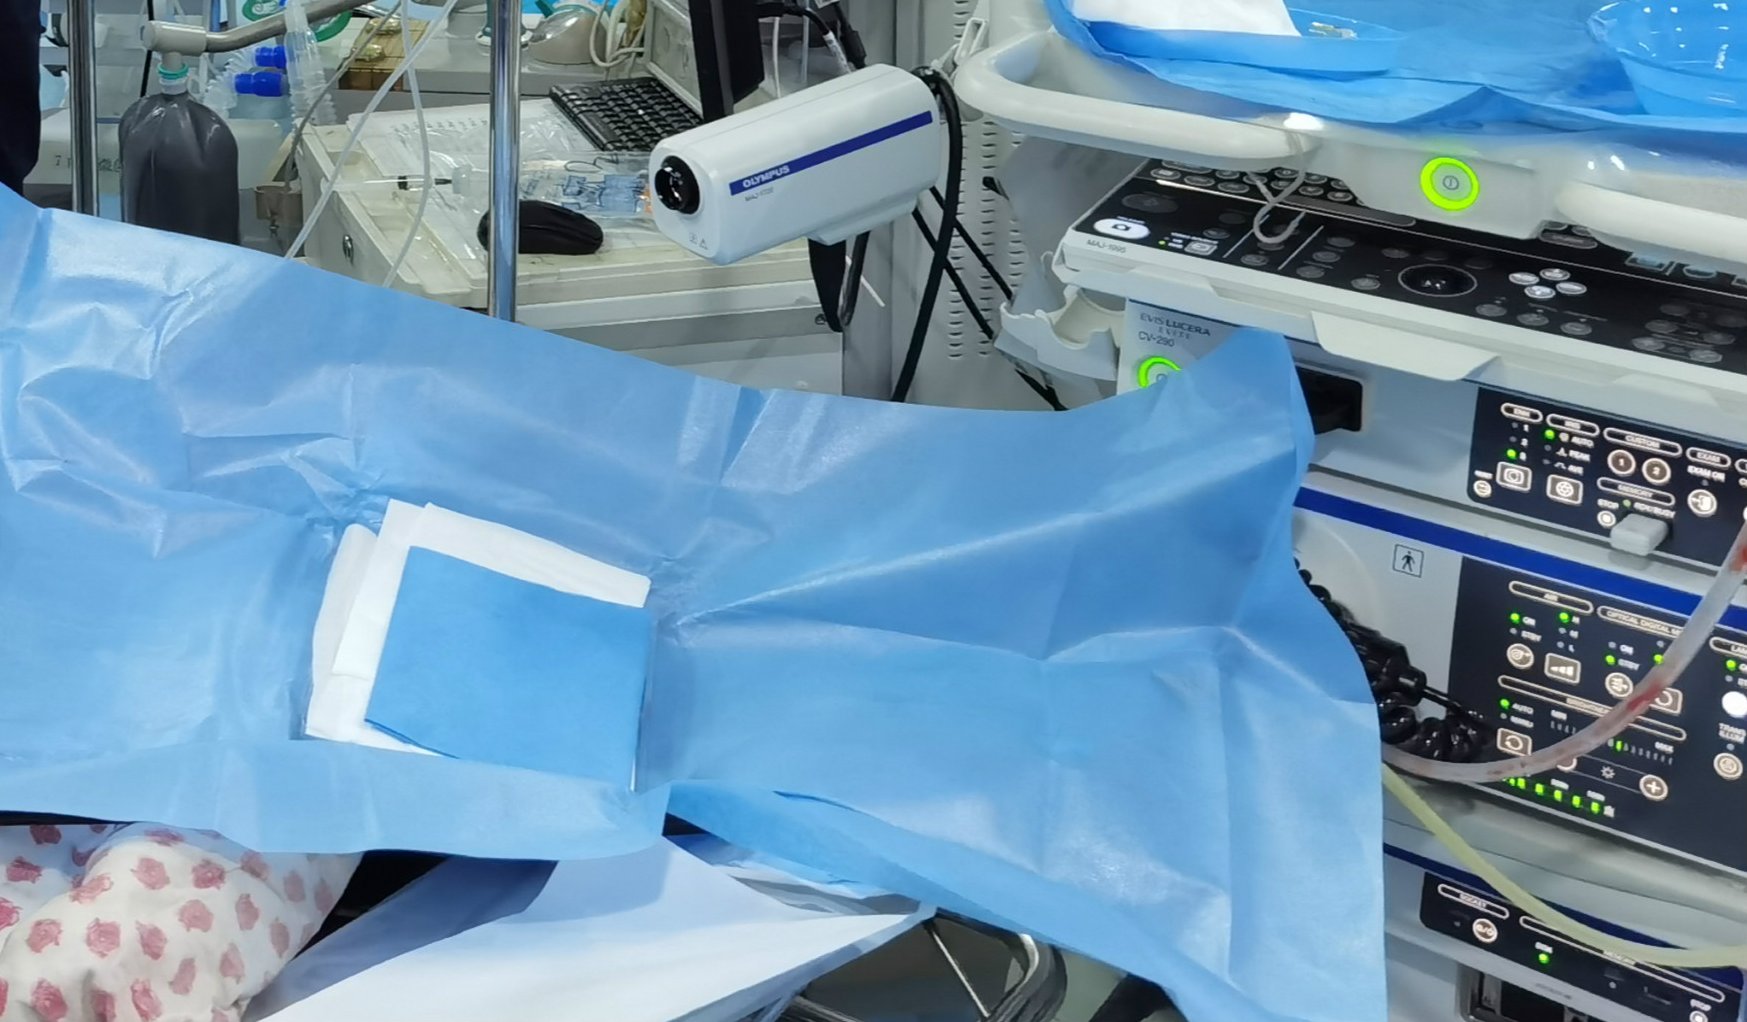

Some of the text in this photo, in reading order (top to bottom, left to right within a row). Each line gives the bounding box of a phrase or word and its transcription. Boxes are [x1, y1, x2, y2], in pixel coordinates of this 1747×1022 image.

[742, 165, 791, 188] OLYMPUS
[1140, 313, 1211, 336] EVIS LUCERA
[1625, 434, 1661, 450] CUSTOM
